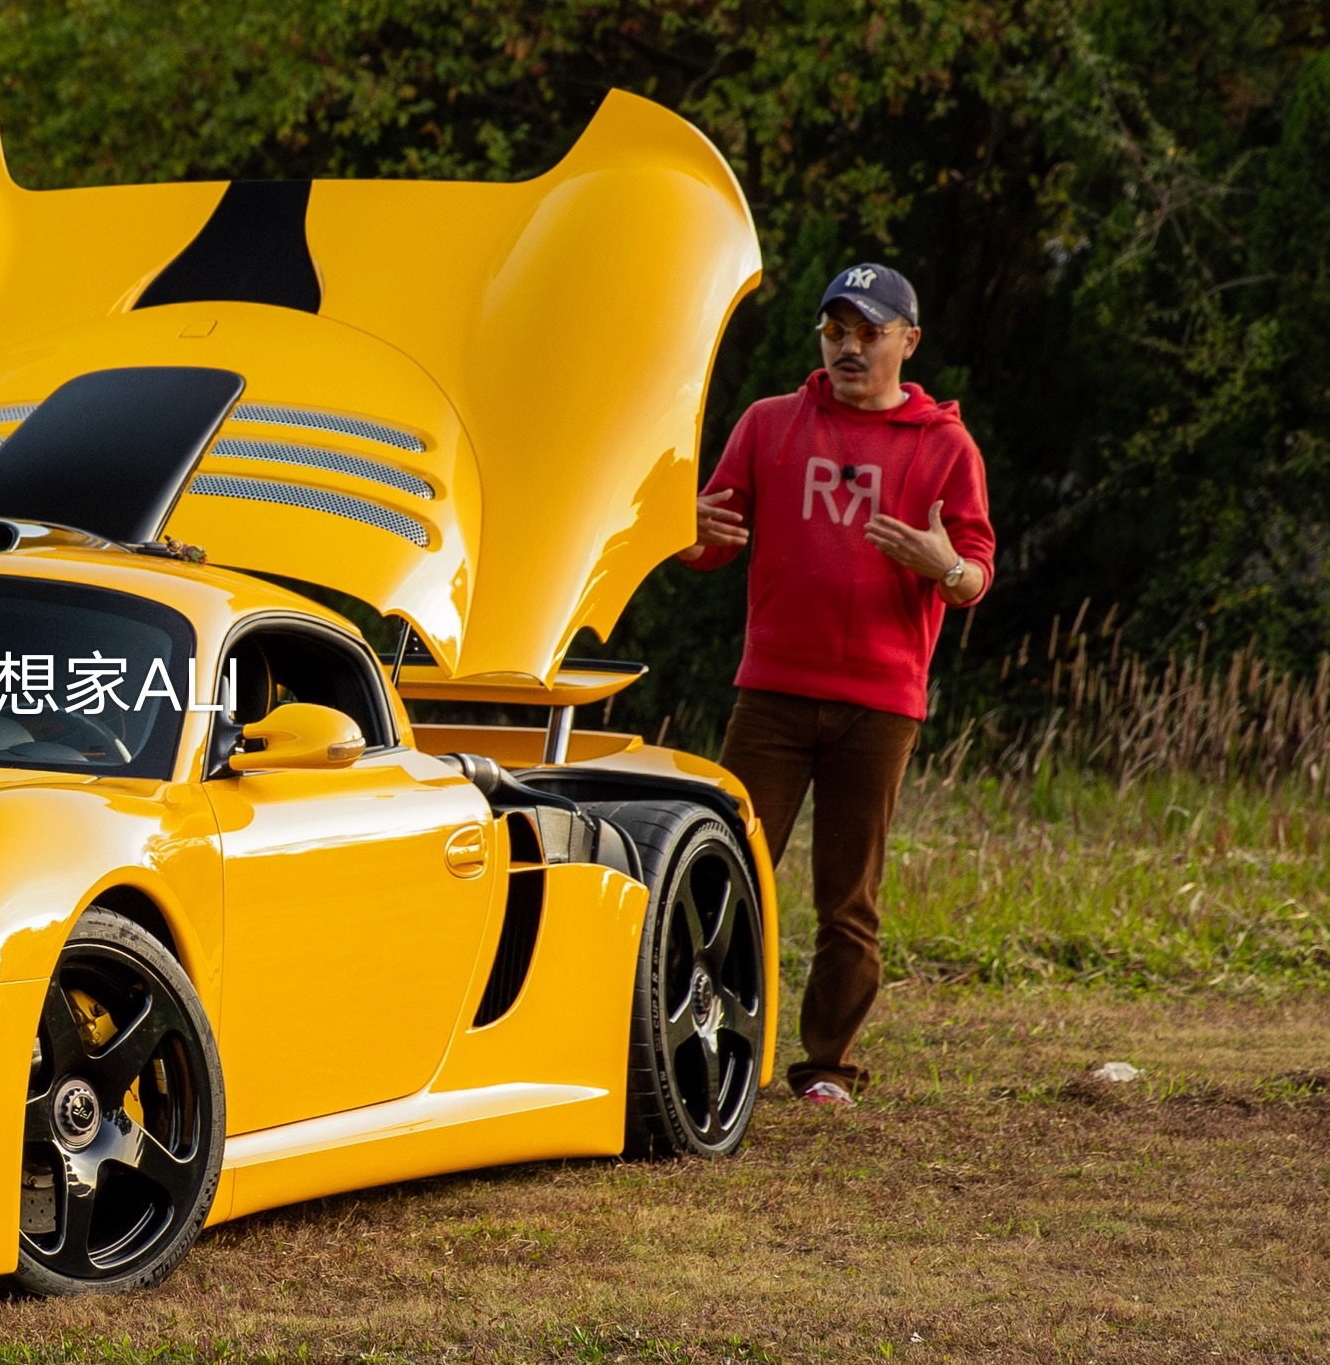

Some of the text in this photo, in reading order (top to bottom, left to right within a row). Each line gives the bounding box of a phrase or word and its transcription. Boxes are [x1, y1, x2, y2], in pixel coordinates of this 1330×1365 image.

[844, 268, 878, 289] NY
[652, 1001, 660, 1029] CUP
[660, 1071, 687, 1143] MICHELIN
[154, 1223, 198, 1278] MICHELIN
